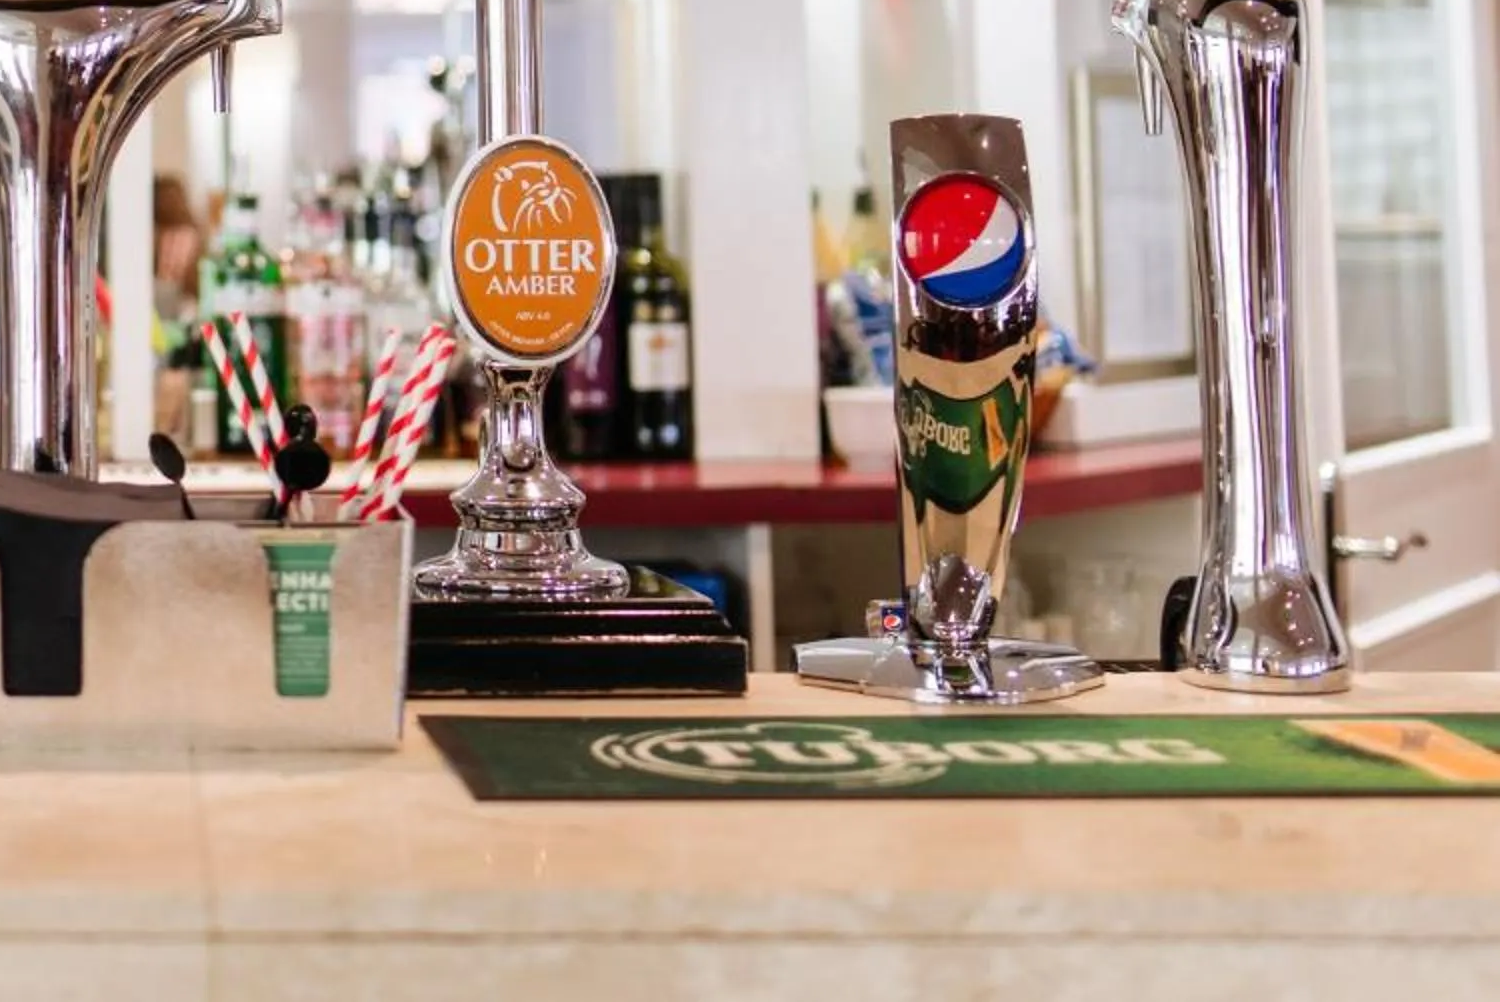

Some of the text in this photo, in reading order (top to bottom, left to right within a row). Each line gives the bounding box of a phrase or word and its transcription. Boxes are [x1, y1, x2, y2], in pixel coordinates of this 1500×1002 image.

[464, 238, 596, 273] OTTER
[486, 275, 577, 295] AMBER
[664, 739, 1228, 767] TUBORG
